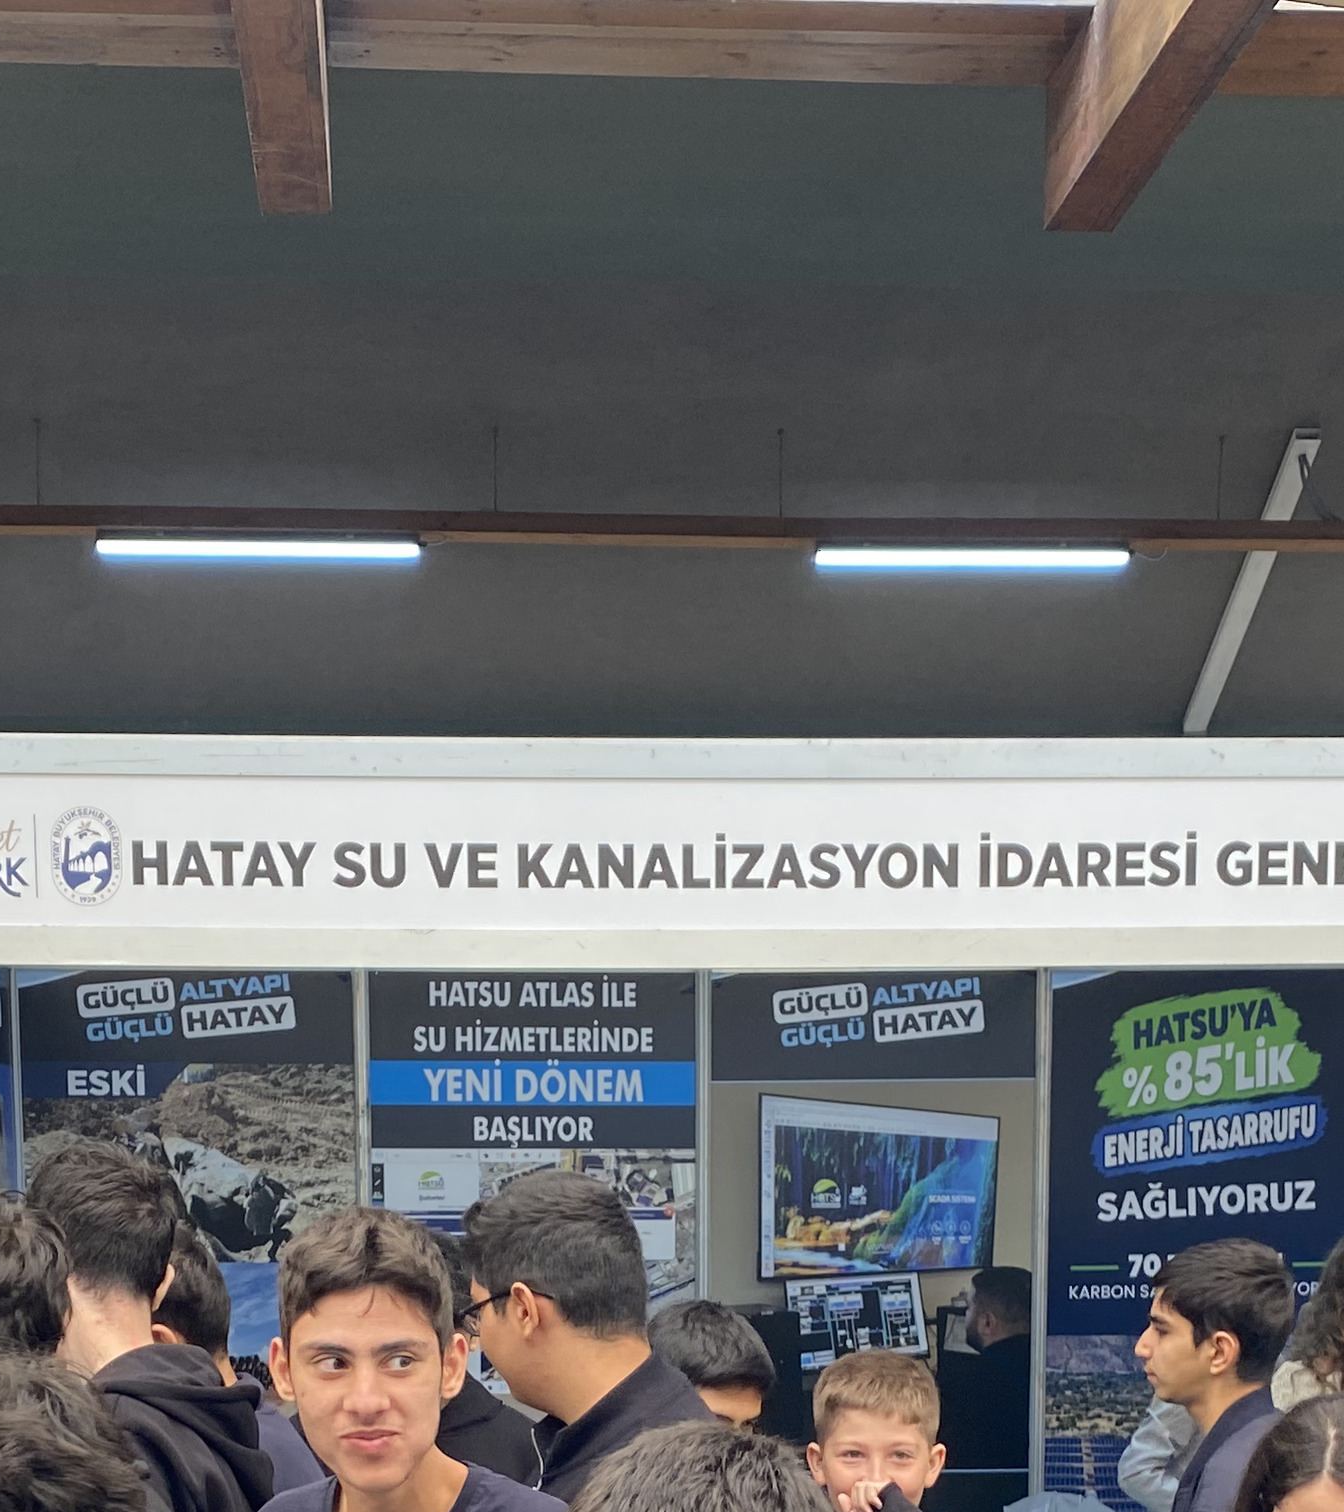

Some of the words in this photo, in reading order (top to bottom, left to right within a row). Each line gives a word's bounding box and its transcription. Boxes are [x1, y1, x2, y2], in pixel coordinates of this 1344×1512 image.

[131, 842, 313, 888] HATAY
[333, 842, 406, 889] SU
[423, 842, 498, 889] VE
[516, 832, 959, 890] KANALİZASYON
[980, 830, 1197, 889] İDARESİ
[80, 981, 169, 1013] GÜÇLÜ
[179, 974, 291, 1000] ALTYAPI
[429, 981, 512, 1008] HATSU
[519, 981, 594, 1008] ATLAS
[601, 974, 637, 1008] İLE
[779, 987, 863, 1017] GÜÇLÜ
[873, 977, 981, 1007] ALTYAPI
[86, 1014, 174, 1043] GÜÇLÜ
[187, 1003, 288, 1032] HATAY
[413, 1026, 447, 1053] SU
[455, 1019, 654, 1053] HİZMETLERİNDE
[781, 1018, 865, 1048] GÜÇLÜ
[878, 1007, 977, 1037] HATAY
[67, 1063, 146, 1097] ESKİ
[423, 1059, 503, 1102] YENİ
[515, 1059, 644, 1102] DÖNEM
[473, 1115, 594, 1148] BAŞLIYOR
[1104, 1115, 1184, 1169] ENERJİ
[1189, 1105, 1316, 1155] TASARRUFU
[1097, 1180, 1317, 1223] SAĞLIYORUZ
[1128, 1254, 1162, 1278] 70
[1069, 1284, 1135, 1300] KARBON
